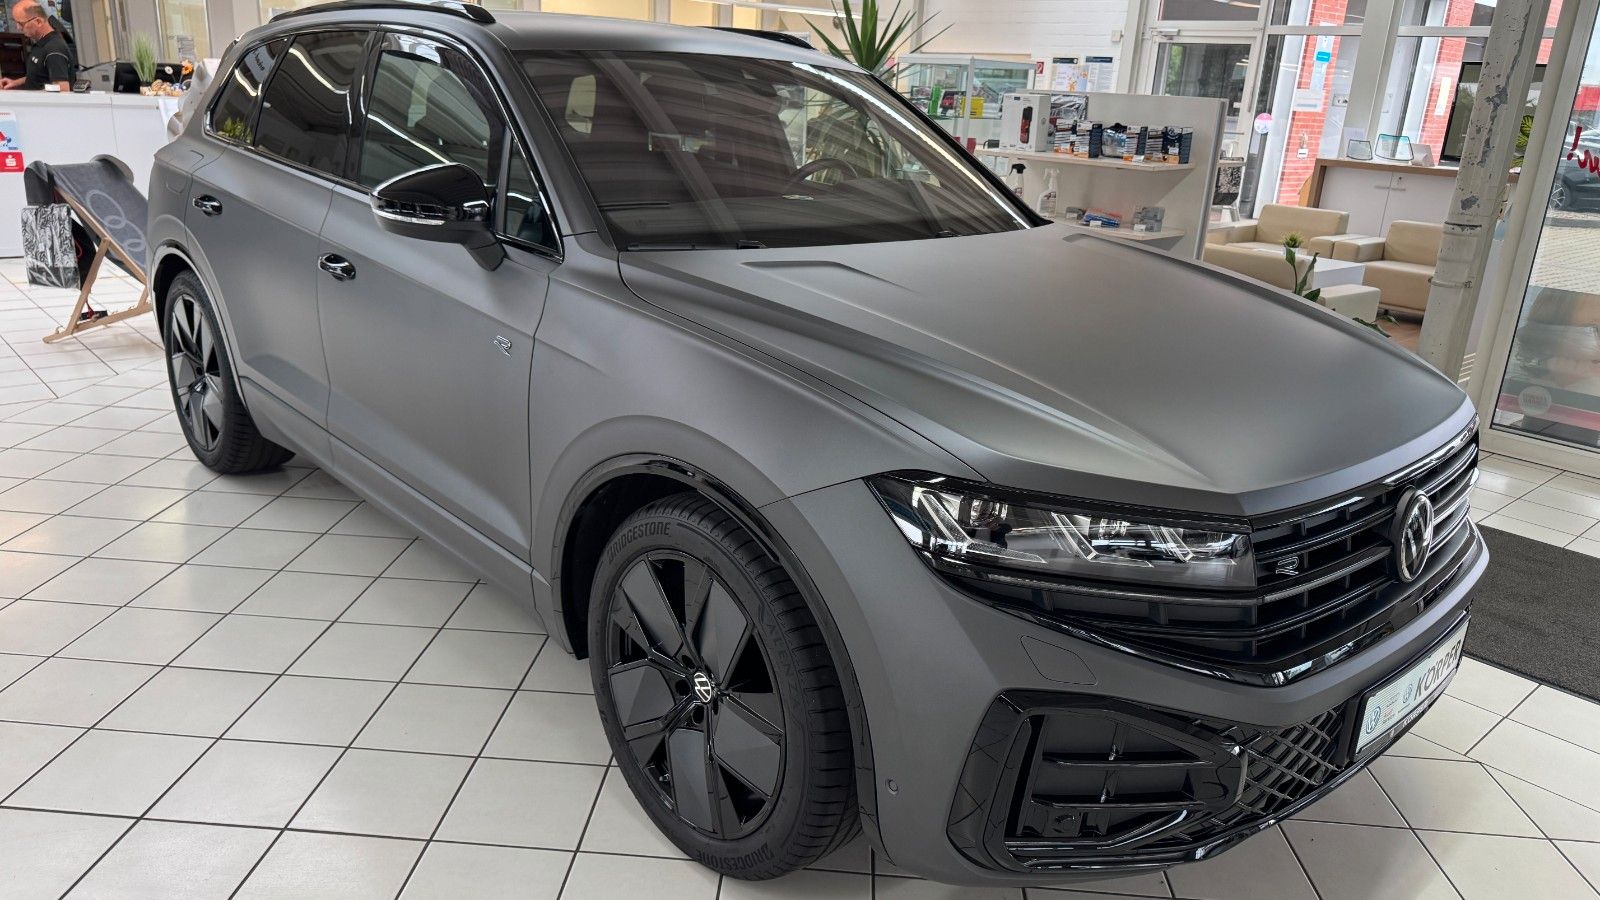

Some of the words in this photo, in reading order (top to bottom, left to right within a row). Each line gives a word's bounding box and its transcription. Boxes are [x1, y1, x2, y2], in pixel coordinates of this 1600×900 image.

[606, 522, 672, 565] BRIDGESTONE
[1414, 639, 1462, 702] KÖRPER
[695, 842, 775, 871] BRIDGESTONE
